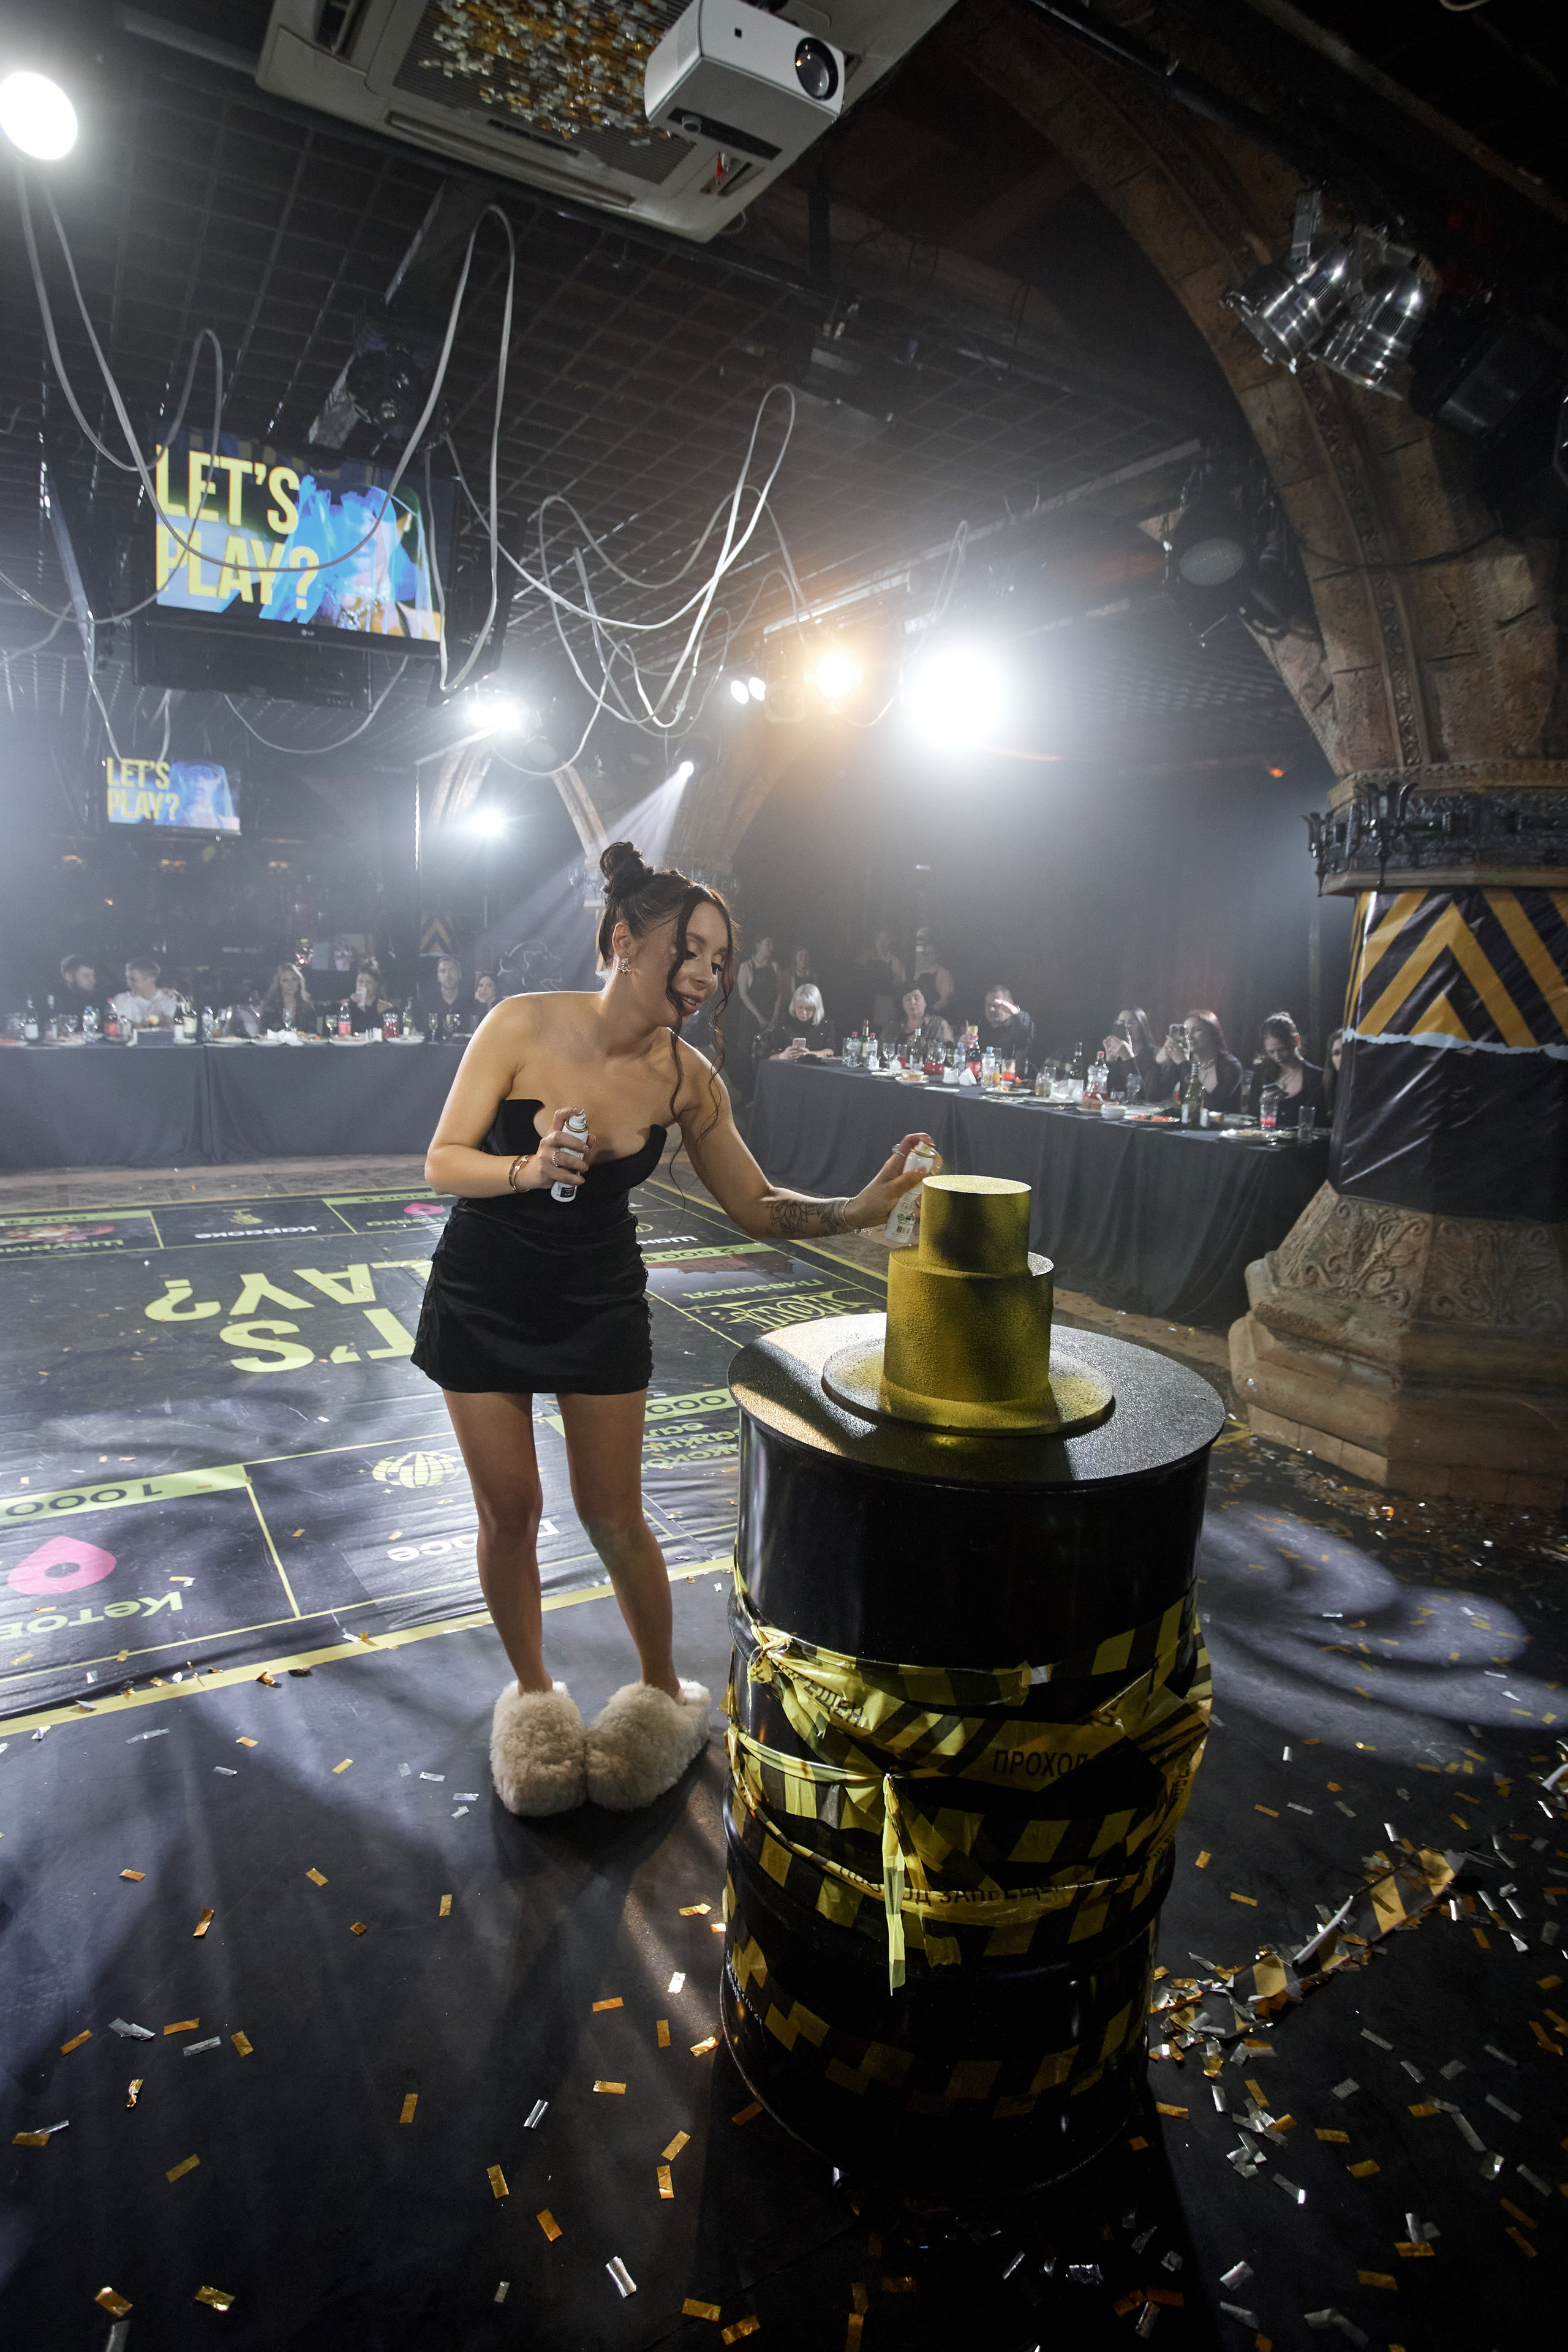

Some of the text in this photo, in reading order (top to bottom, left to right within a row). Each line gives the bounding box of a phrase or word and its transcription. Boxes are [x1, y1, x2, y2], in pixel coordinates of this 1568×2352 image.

[156, 444, 299, 535] LET'S
[156, 524, 319, 610] PLAY?
[107, 756, 170, 790] LET'S
[107, 788, 180, 822] PLAY?
[195, 1225, 318, 1239] Караоке
[636, 1235, 699, 1245] Шан
[0, 1239, 124, 1253] Шаурм
[681, 1279, 824, 1299] Пивзавод
[219, 1308, 417, 1373] T'S
[643, 1422, 704, 1439] сал
